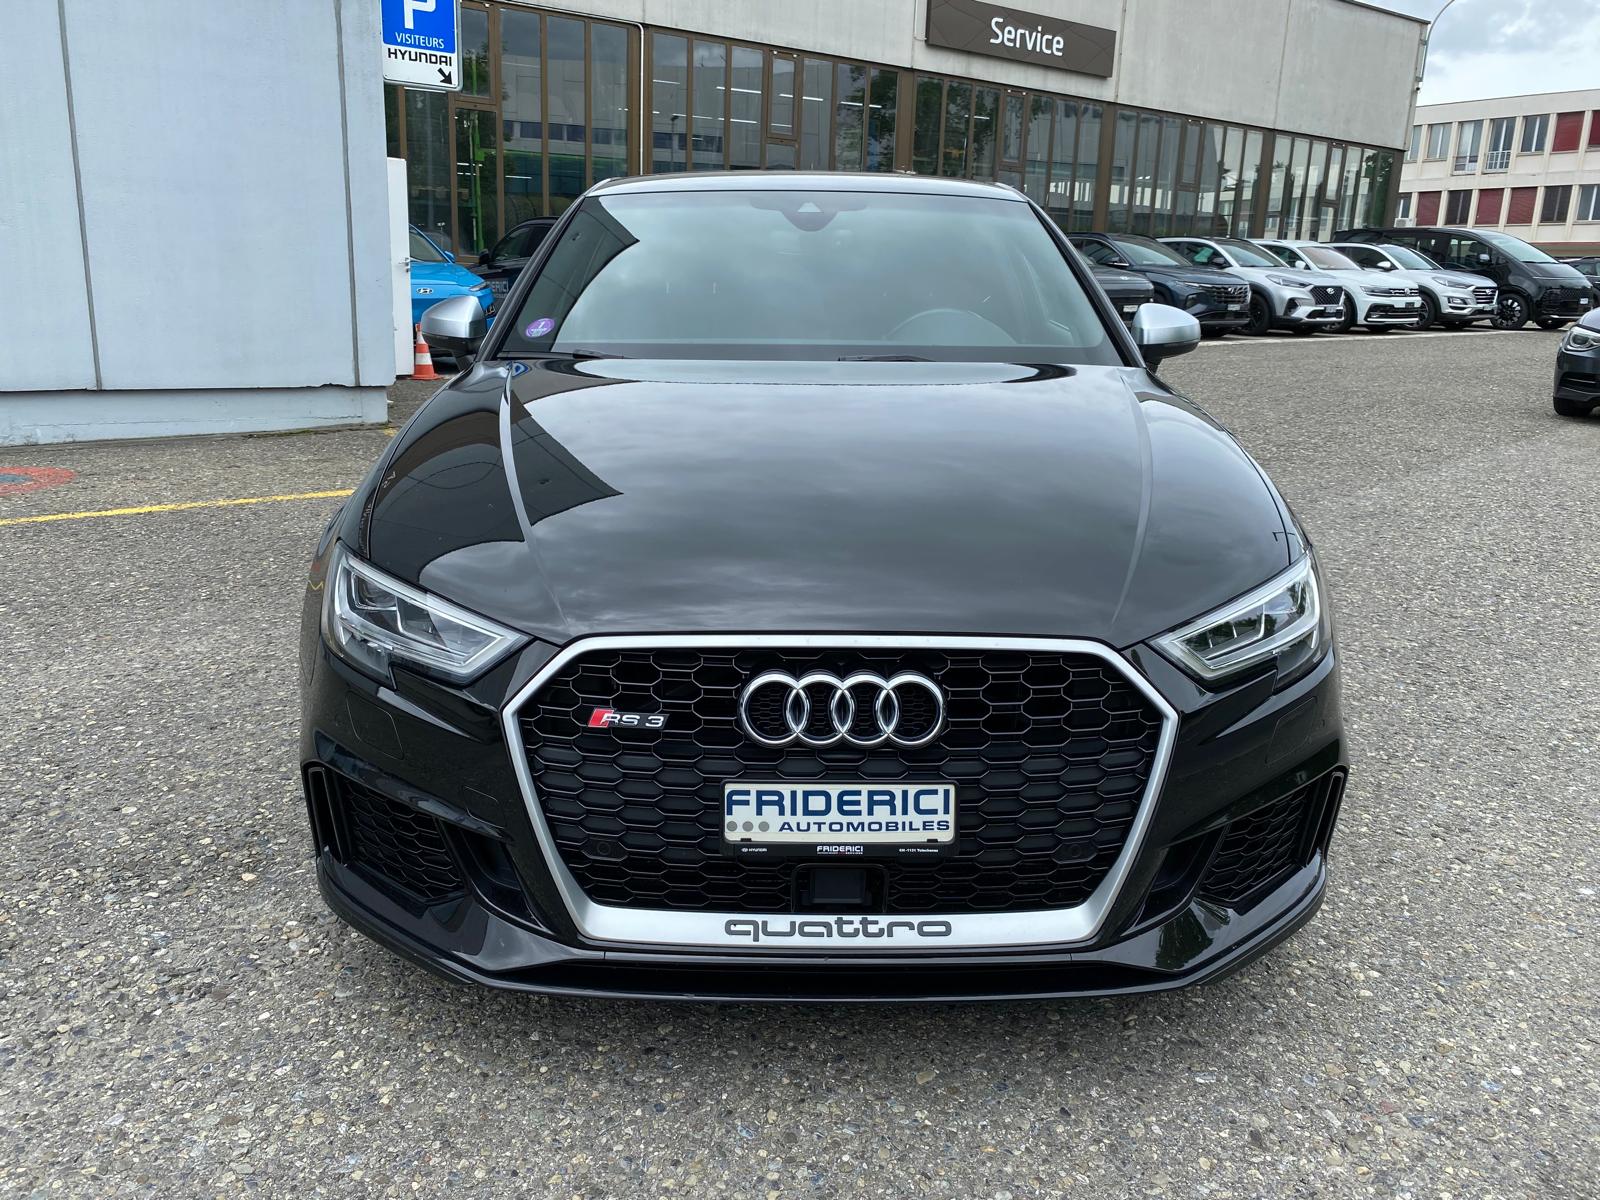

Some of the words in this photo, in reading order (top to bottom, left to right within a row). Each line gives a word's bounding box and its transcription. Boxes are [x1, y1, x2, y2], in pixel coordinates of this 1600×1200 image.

[403, 0, 436, 29] P
[395, 32, 445, 49] VISITEURS
[989, 17, 1064, 56] Service
[387, 47, 452, 67] HYUNDAI
[600, 712, 640, 726] RS
[645, 715, 664, 727] 3
[726, 788, 951, 817] FRIDERICI
[778, 820, 950, 833] AUTOMOBILES
[724, 916, 952, 942] quattro
